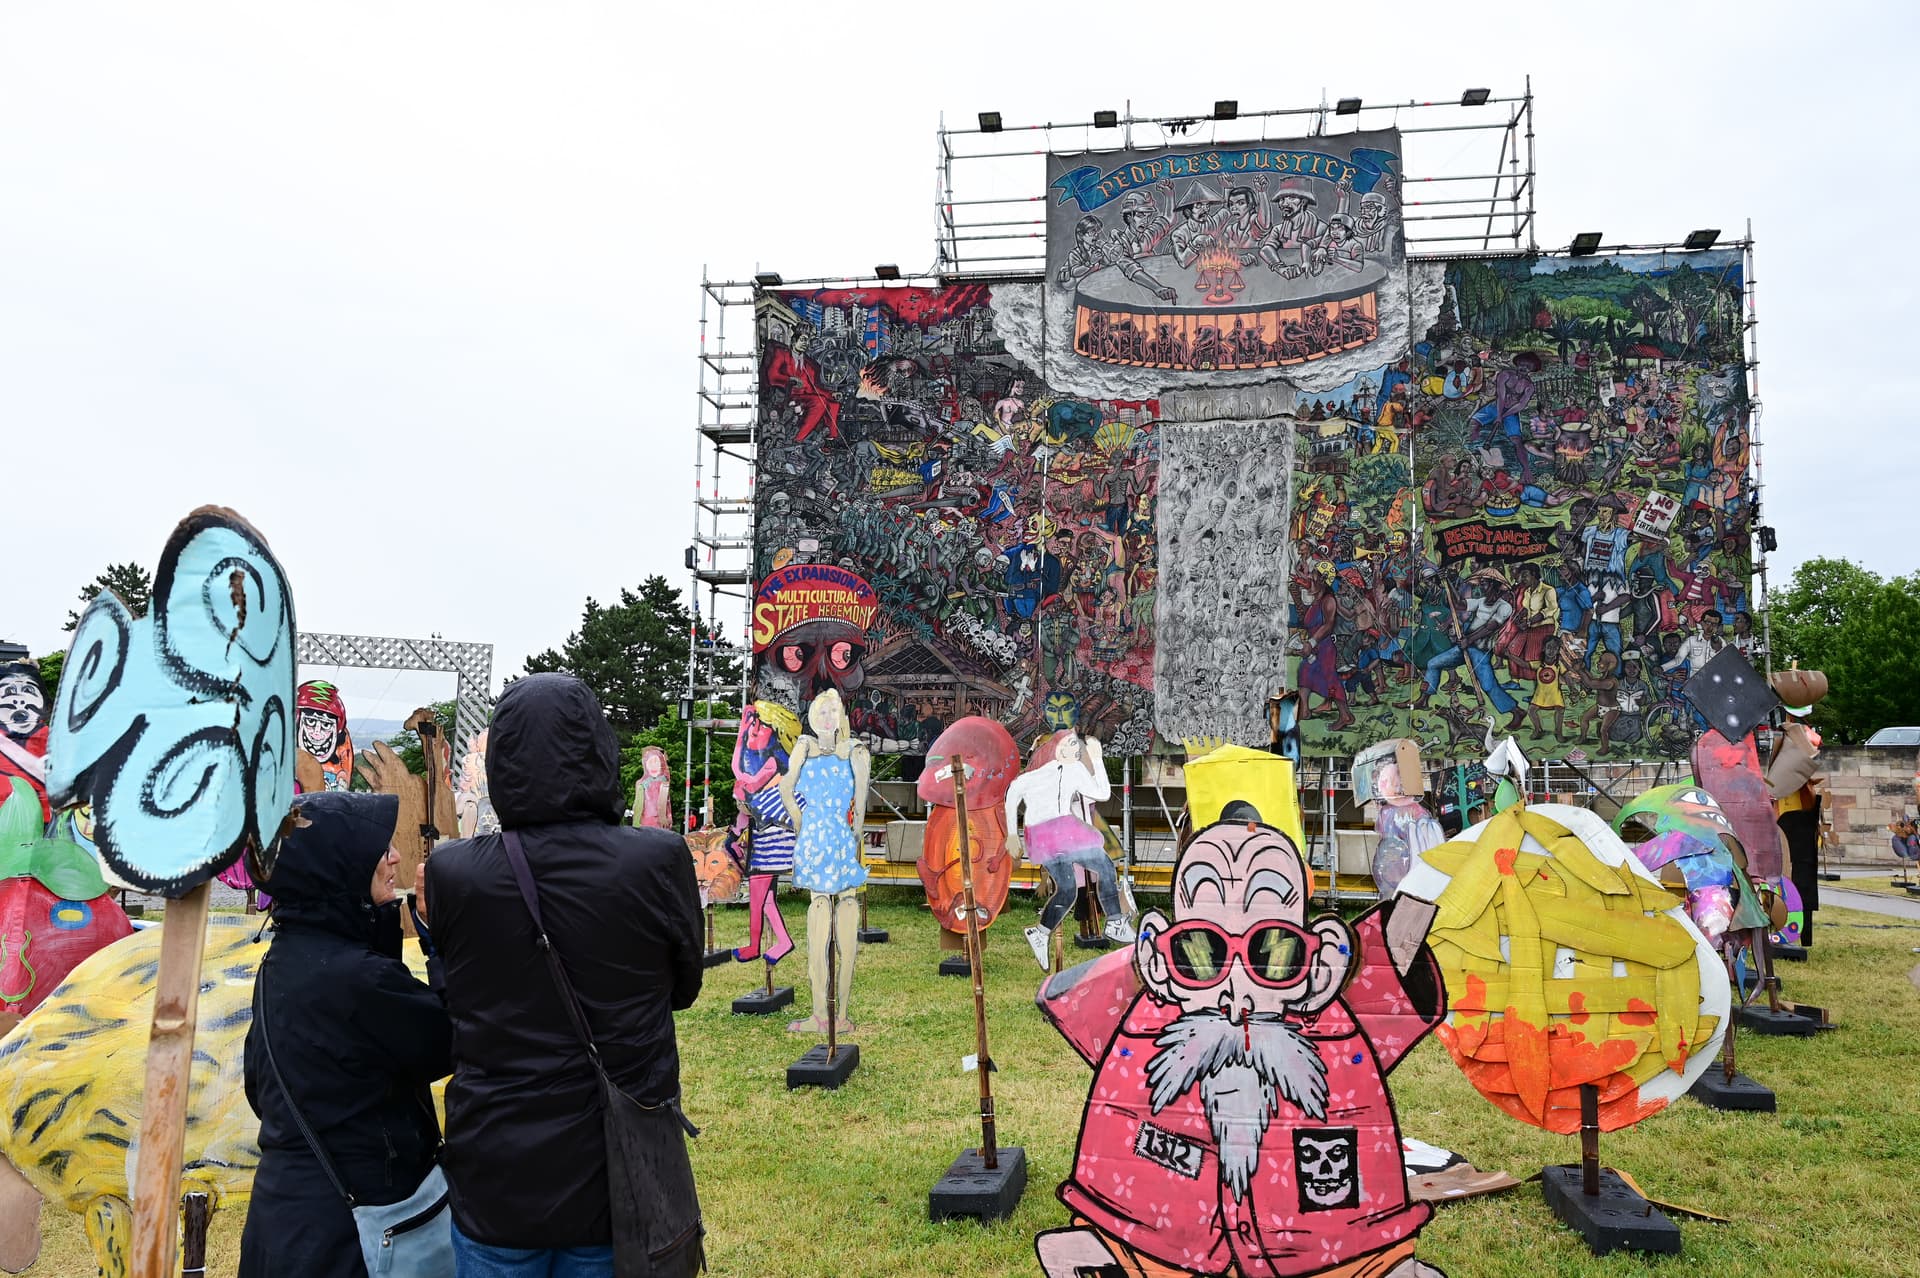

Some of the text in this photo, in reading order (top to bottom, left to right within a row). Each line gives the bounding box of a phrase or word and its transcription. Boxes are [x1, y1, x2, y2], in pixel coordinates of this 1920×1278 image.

[1098, 152, 1359, 199] PEOPLE'S JUSTICE
[1655, 495, 1674, 510] NO
[1443, 525, 1531, 546] RESISTANCE
[1448, 542, 1548, 556] CULTURE MOVEMENT
[759, 567, 871, 600] THE EXPANSION OF
[754, 603, 876, 646] STATE HEGEMONY
[1143, 1128, 1191, 1169] 1312
